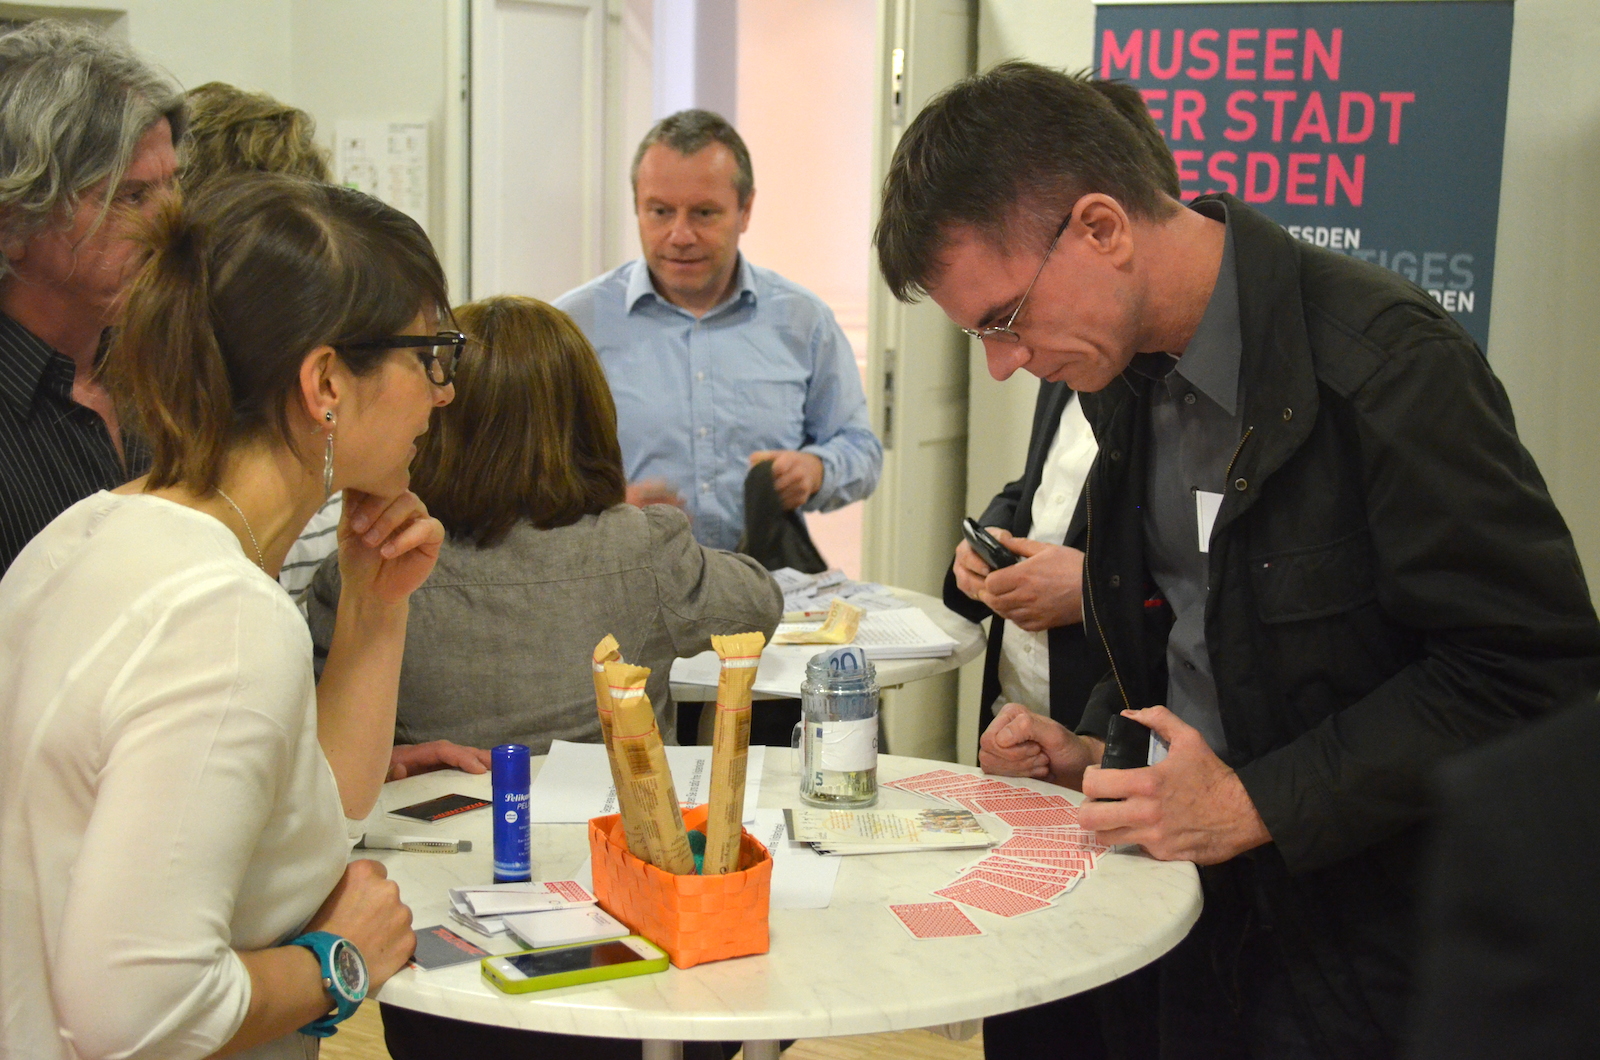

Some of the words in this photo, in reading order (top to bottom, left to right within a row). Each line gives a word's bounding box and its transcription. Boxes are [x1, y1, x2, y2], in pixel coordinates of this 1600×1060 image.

[1100, 28, 1343, 81] MUSEEN
[1223, 89, 1416, 145] STADT
[1280, 224, 1361, 249] ESDEN
[1333, 249, 1474, 290] TIGES
[815, 771, 823, 786] 5
